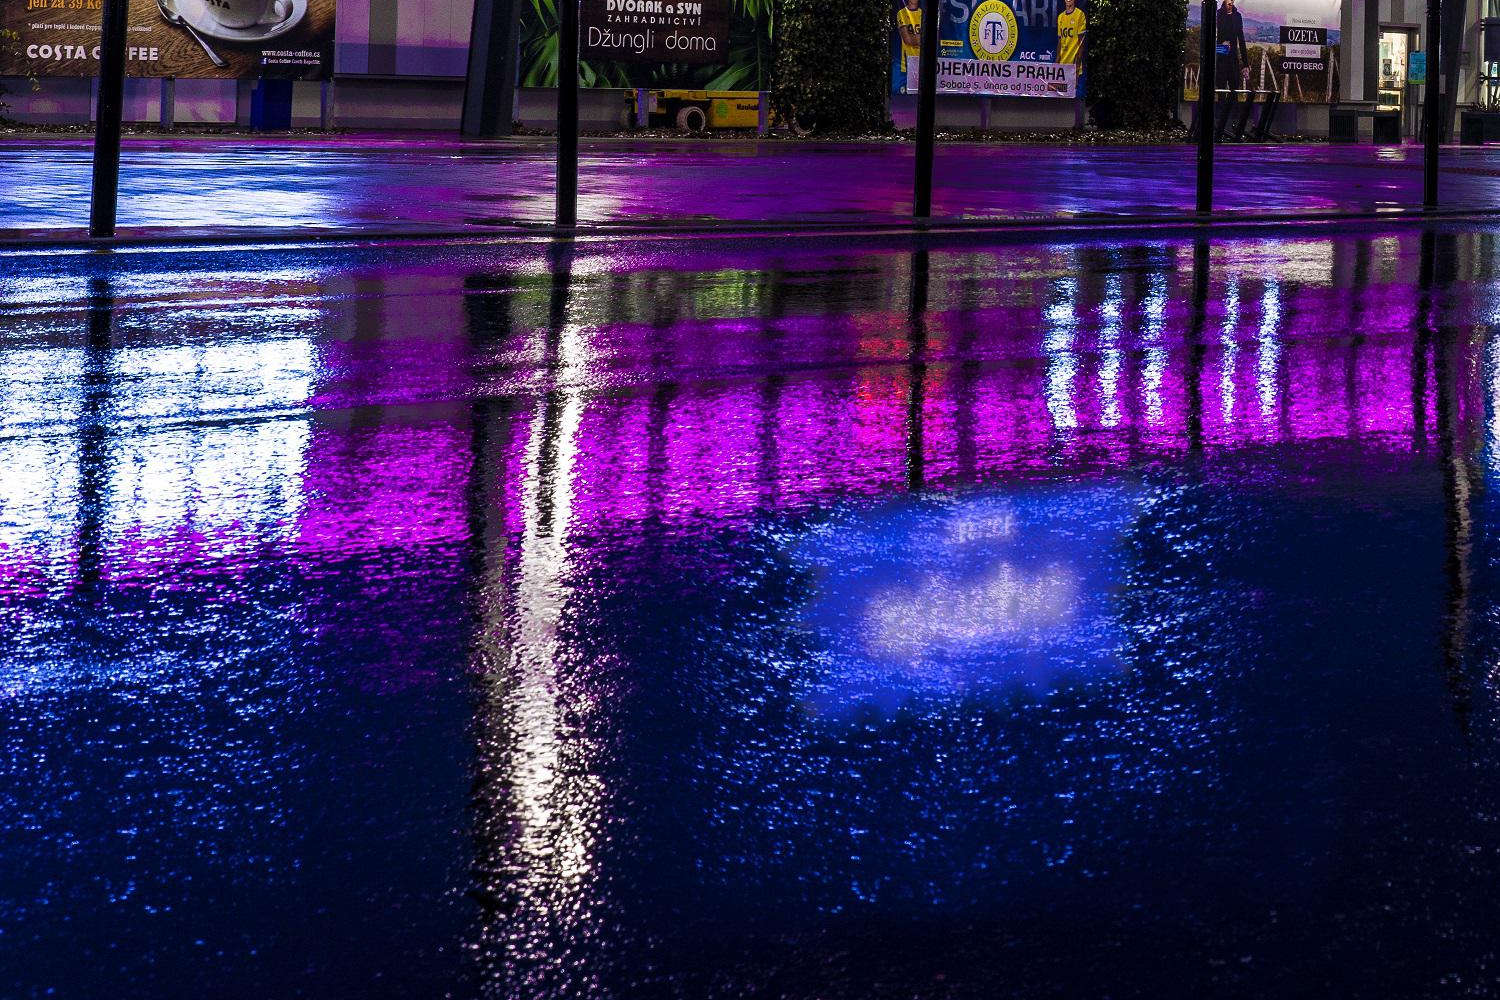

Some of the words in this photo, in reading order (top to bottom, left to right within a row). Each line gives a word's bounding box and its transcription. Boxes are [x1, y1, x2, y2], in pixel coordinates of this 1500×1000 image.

[665, 4, 674, 14] a
[677, 2, 702, 15] SYN
[607, 14, 701, 27] ZAHRADNICTVÍ
[588, 26, 655, 54] Džungli
[665, 30, 716, 51] doma
[1288, 29, 1319, 43] OZETA
[26, 44, 87, 61] COSTA
[92, 46, 159, 61] CFEE
[1019, 51, 1036, 60] AGC
[1282, 61, 1302, 70] OTTO
[1303, 62, 1324, 71] BERG
[1016, 65, 1066, 81] PRAHA
[940, 80, 971, 90] Sobota
[973, 81, 982, 90] 5.
[984, 80, 1009, 91] února
[1011, 82, 1021, 91] od
[1023, 83, 1046, 92] 15:00
